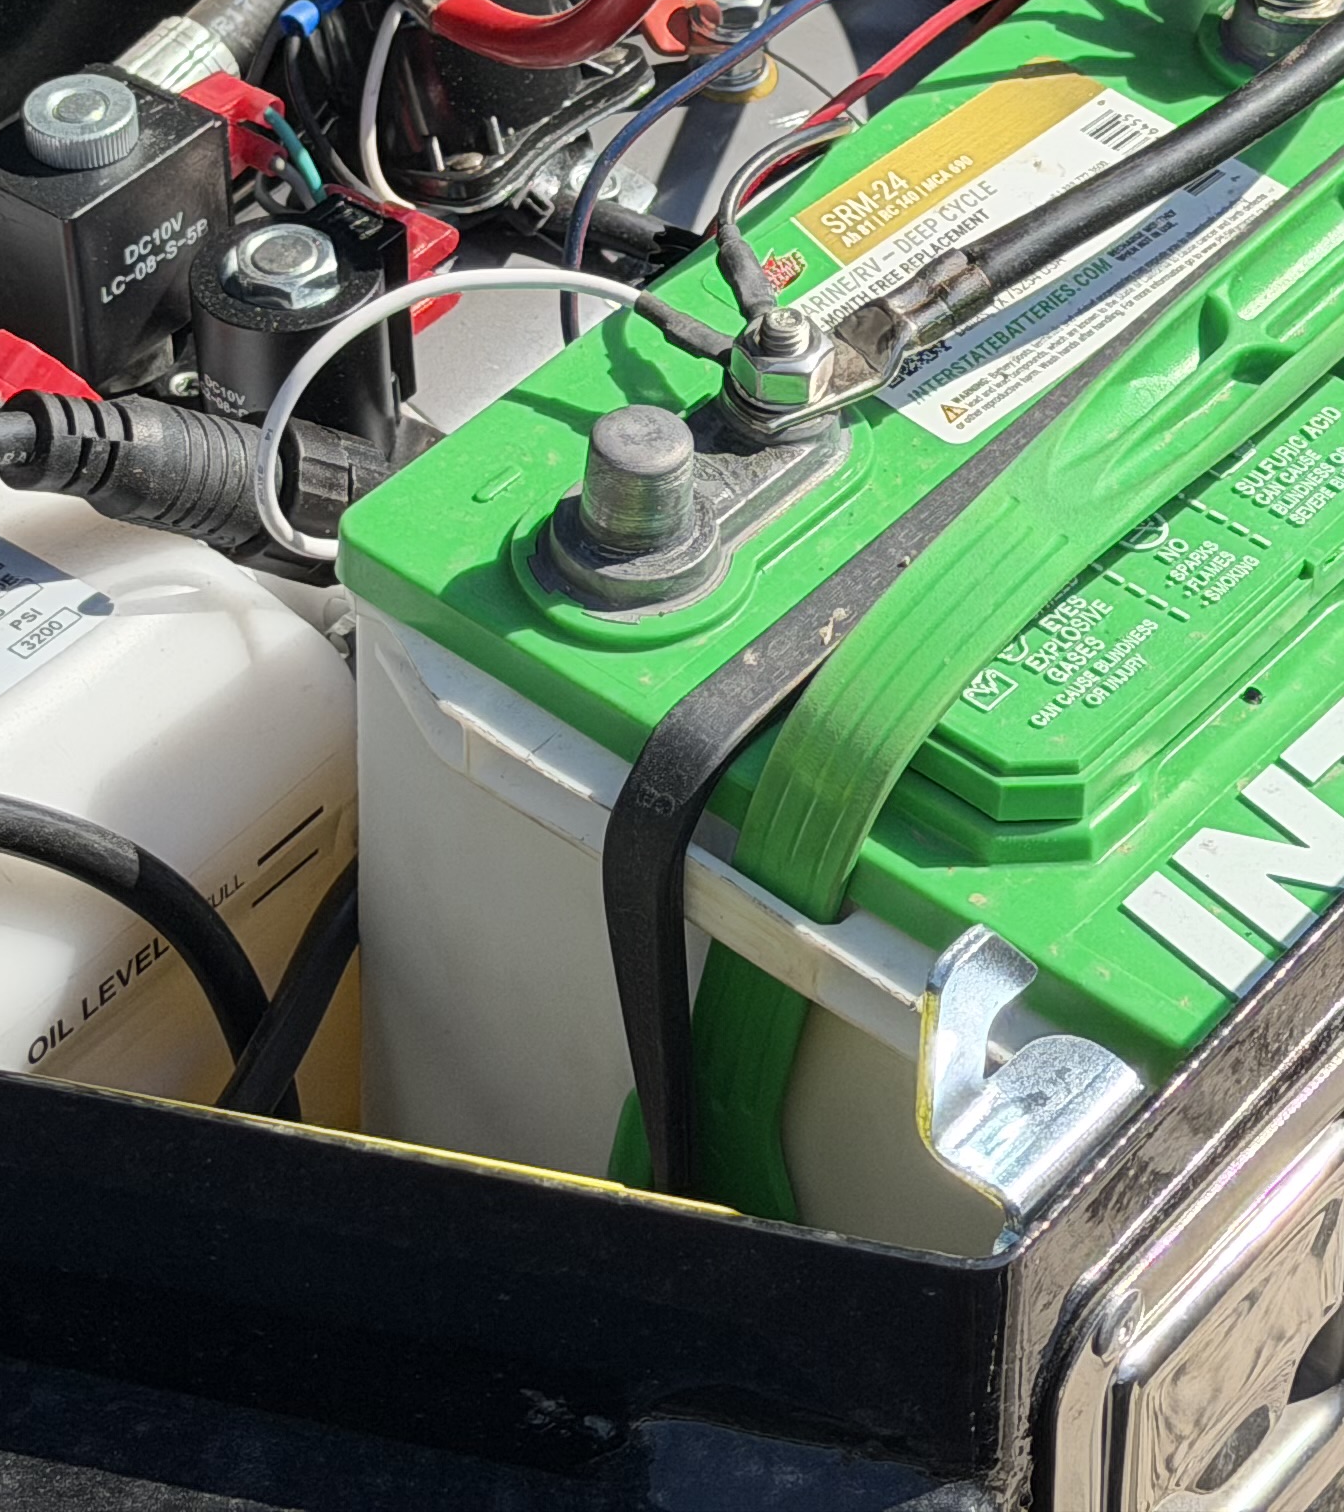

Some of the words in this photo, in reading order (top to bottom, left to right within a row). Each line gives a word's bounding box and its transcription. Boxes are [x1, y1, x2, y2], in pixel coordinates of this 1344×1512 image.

[821, 171, 909, 234] SRM-24
[841, 231, 863, 248] Ah
[856, 219, 877, 236] 81
[877, 204, 901, 222] RC
[895, 190, 920, 209] 140
[920, 169, 953, 192] MCA
[948, 155, 974, 174] 690
[892, 217, 938, 254] DEEP
[937, 180, 998, 222] CYCLE
[124, 211, 183, 265] DC10V
[867, 268, 904, 296] FREE
[899, 208, 989, 274] REPLACEMENT
[908, 258, 1111, 399] INTERSTATEBATTERIES.COM
[1235, 435, 1312, 498] SULFURIC
[1300, 406, 1342, 440] ACID
[1251, 480, 1287, 505] CAN
[1279, 448, 1322, 484] CAUSE
[1268, 462, 1336, 515] BLINDNESS
[1288, 486, 1337, 525] SEVERE
[1153, 537, 1189, 564] NO
[1169, 540, 1221, 581] SPARKS
[1182, 550, 1236, 593] FLAMES
[1199, 554, 1260, 601] SMOKING
[8, 607, 43, 631] PSI
[20, 620, 64, 652] 3200
[1021, 599, 1113, 671] EXPLOSIVE
[1039, 594, 1093, 633] EYES
[1030, 701, 1063, 726] CAN
[1052, 669, 1101, 705] CAUSE
[1093, 618, 1159, 673] BLINDNESS
[1046, 635, 1105, 683] GASES
[1081, 686, 1111, 705] OR
[1102, 652, 1148, 691] INJURY
[28, 1019, 74, 1065] OIL
[81, 937, 169, 1021] LEVEL
